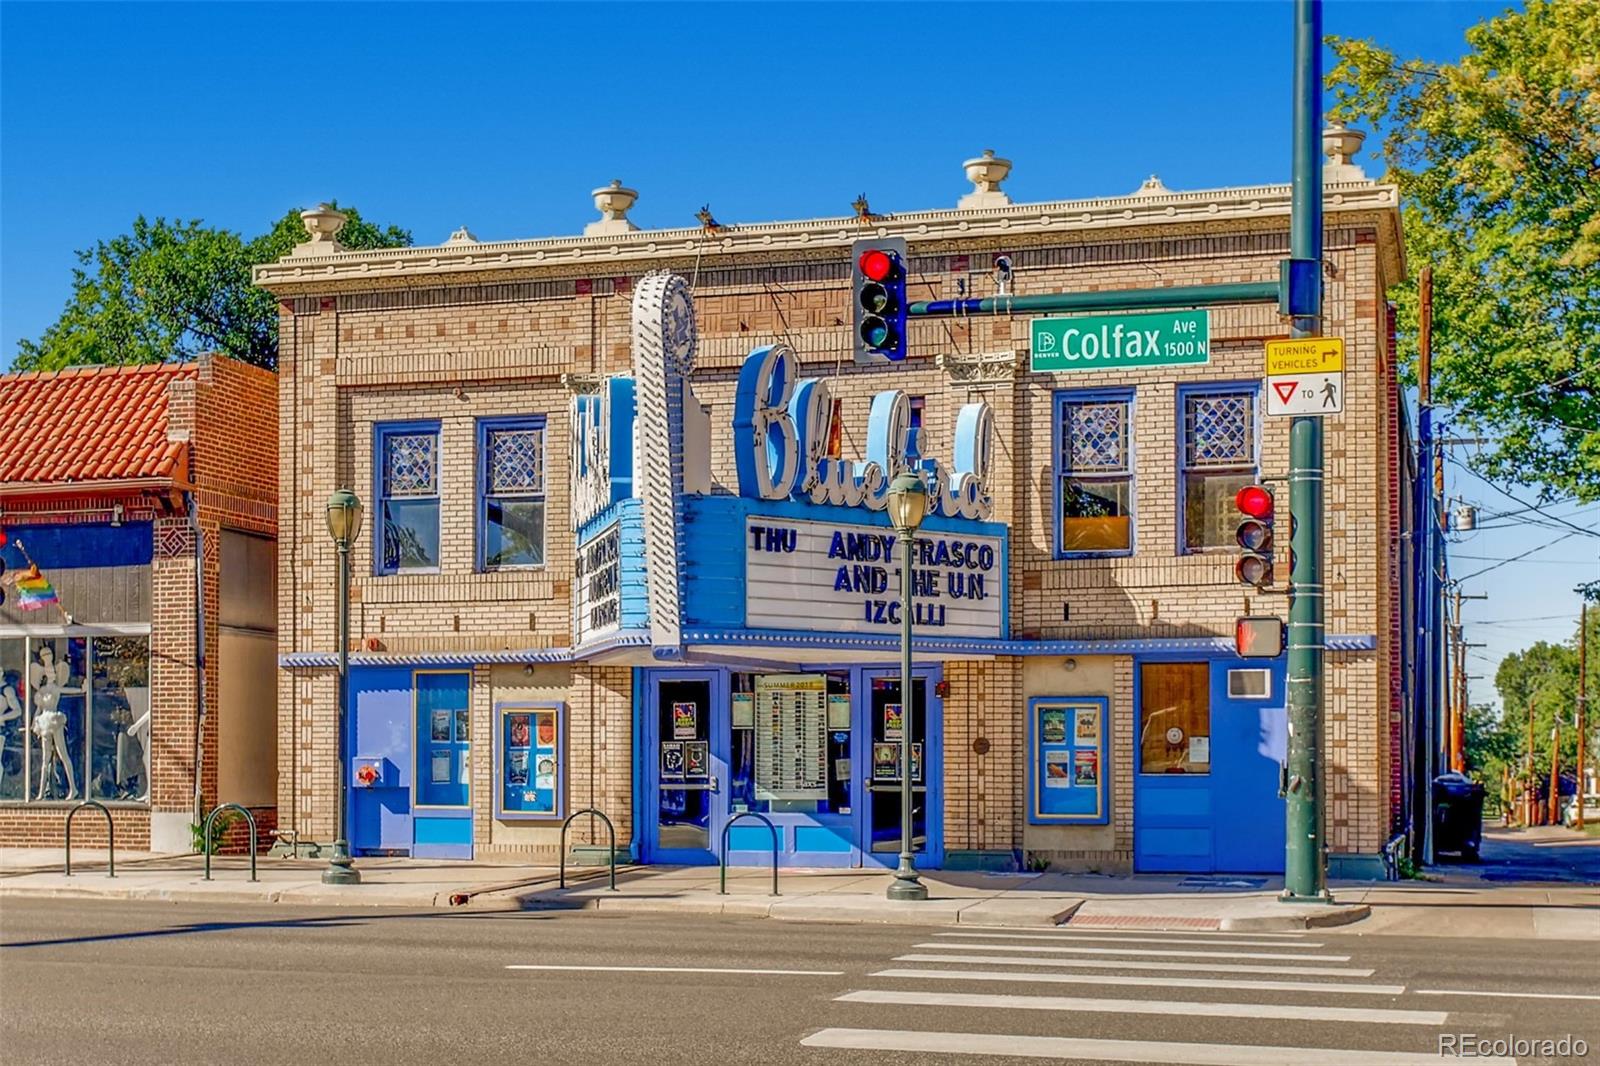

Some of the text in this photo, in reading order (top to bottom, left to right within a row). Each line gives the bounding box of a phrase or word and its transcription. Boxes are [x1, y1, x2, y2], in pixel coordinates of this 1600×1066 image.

[1173, 319, 1197, 334] Ave
[1062, 324, 1161, 361] Colfax
[1164, 340, 1206, 357] 1500 N
[1273, 345, 1317, 356] TURNING
[1272, 359, 1318, 369] VEHICLES
[1302, 389, 1314, 399] TO
[750, 526, 994, 571] THU ANDY FRASCO
[833, 565, 888, 595] AND
[948, 571, 989, 601] U.N.
[865, 600, 946, 627] IZCLLI
